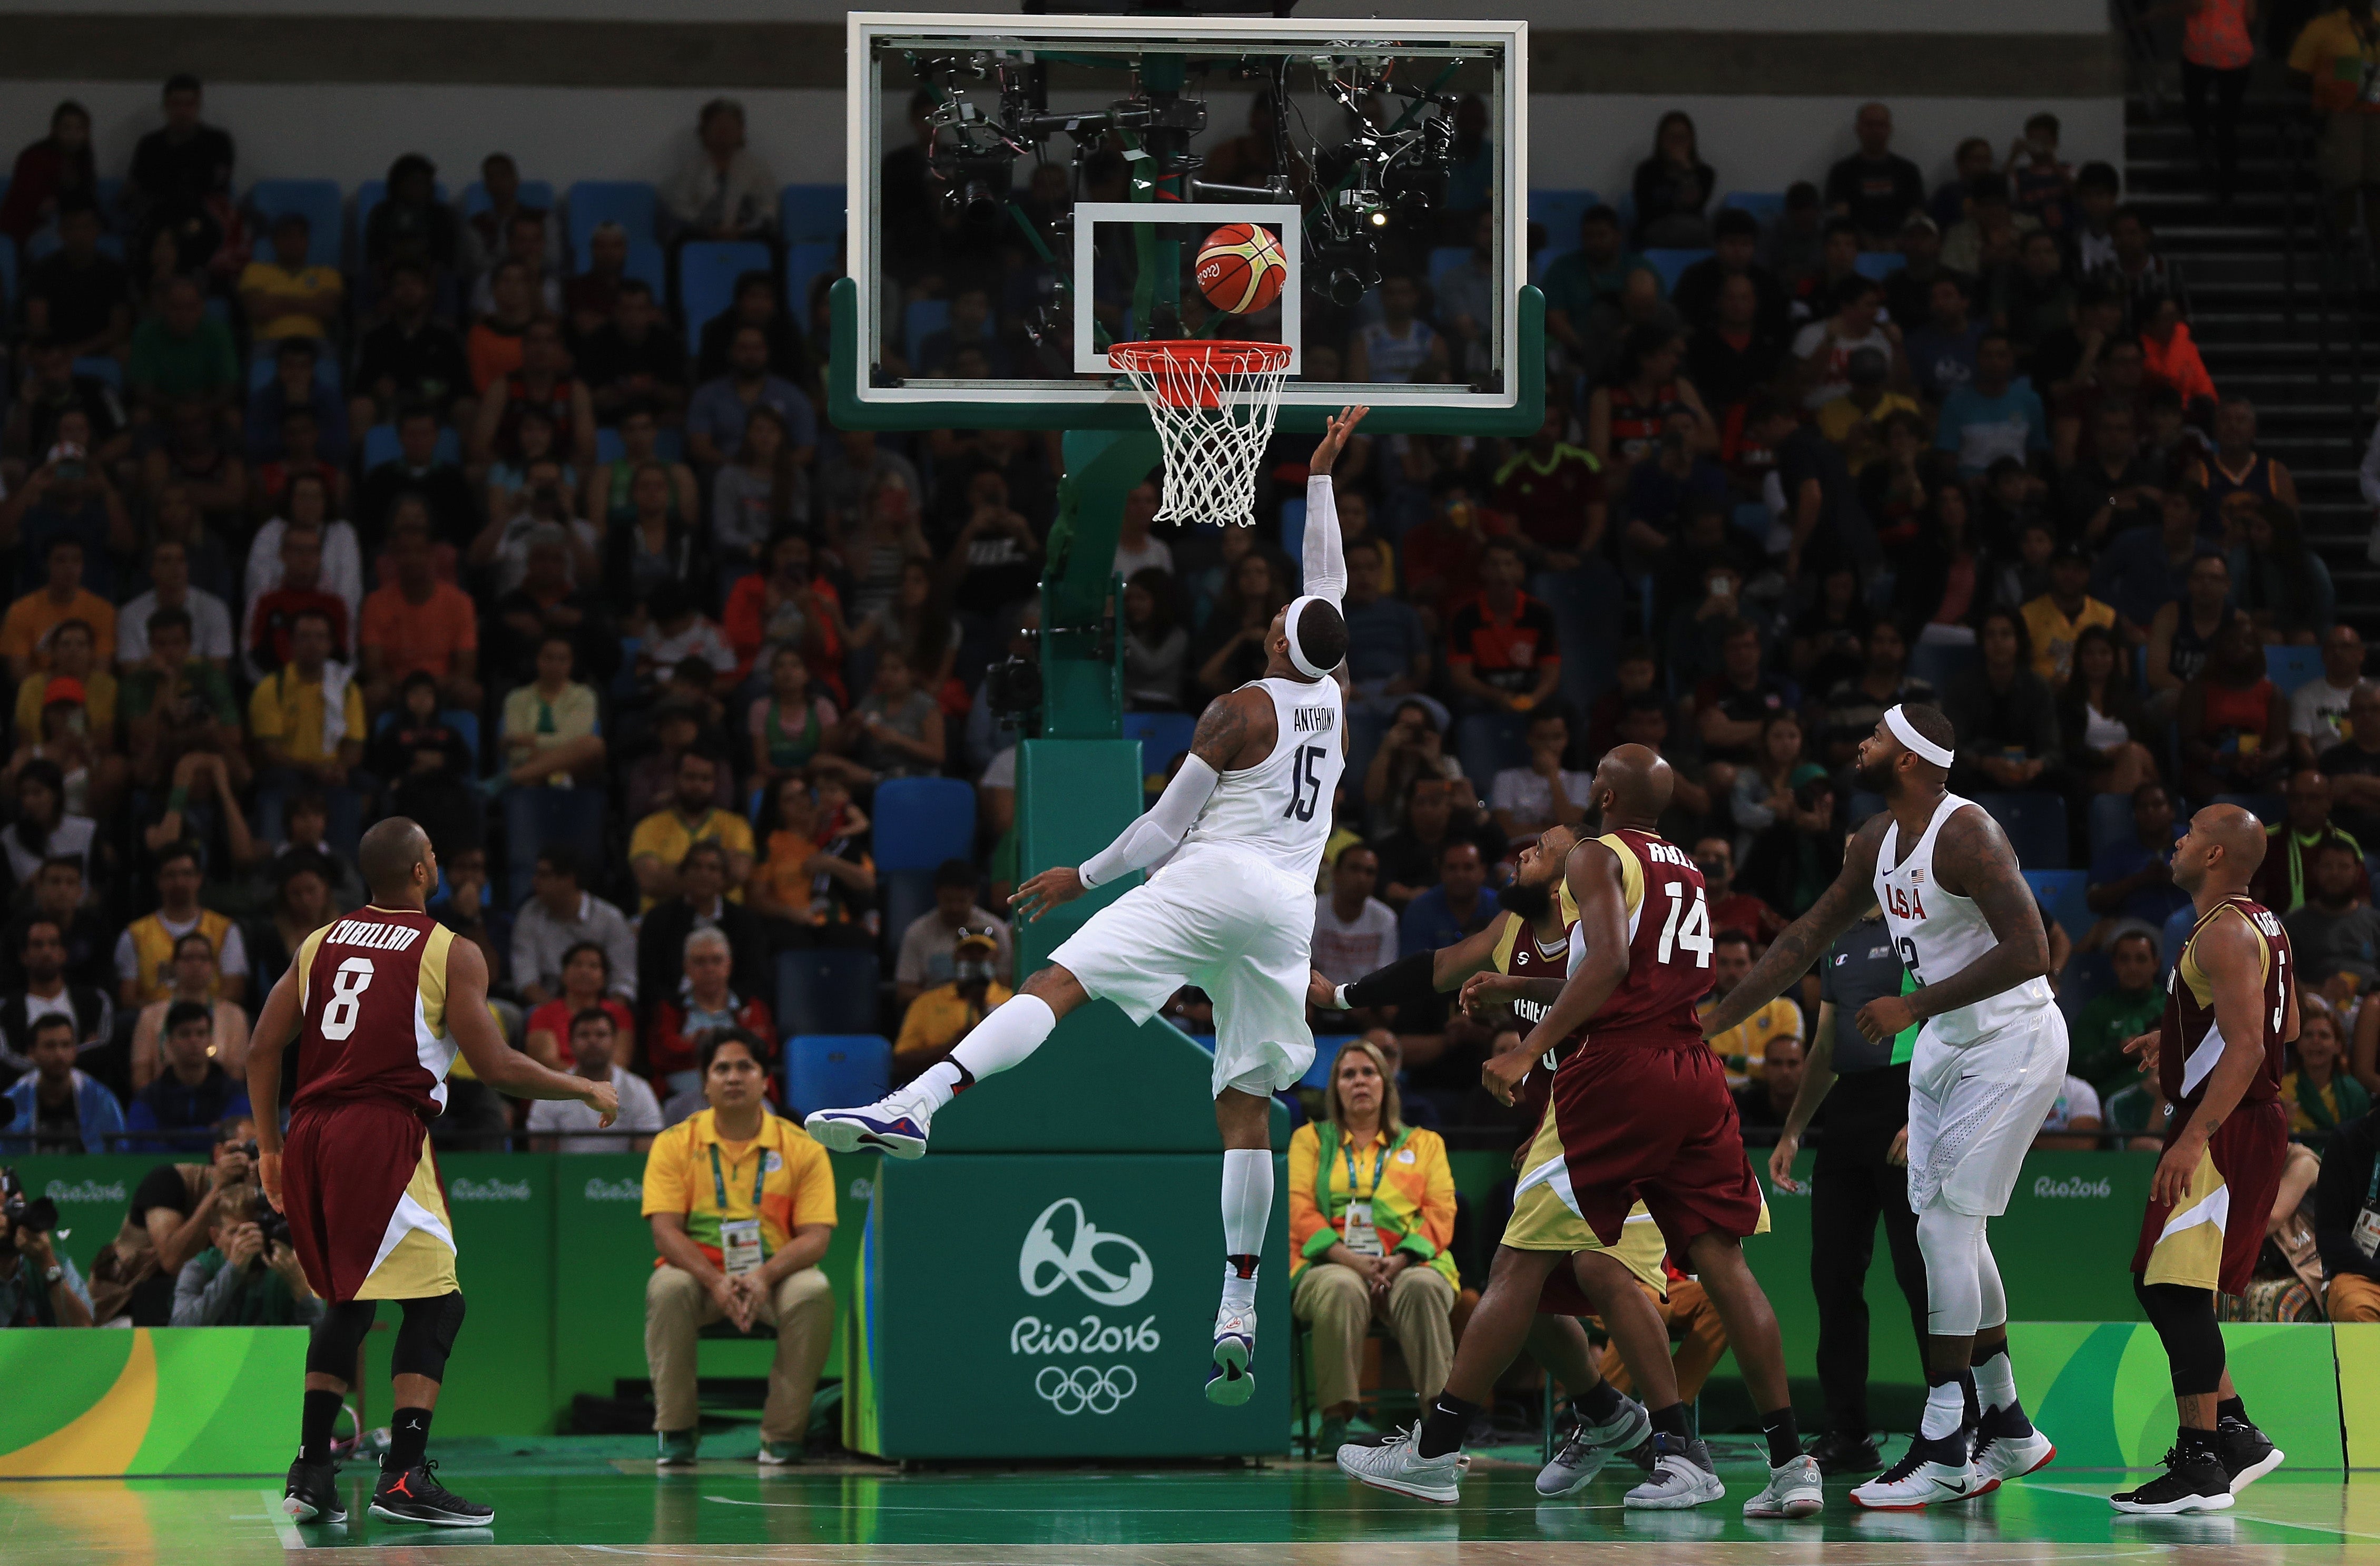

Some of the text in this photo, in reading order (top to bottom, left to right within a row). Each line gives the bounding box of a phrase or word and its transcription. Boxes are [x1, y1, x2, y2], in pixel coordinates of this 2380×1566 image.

[1294, 707, 1335, 732] ANTHONY
[1283, 744, 1327, 823] 15
[1885, 883, 1927, 920] USA
[326, 919, 421, 952] CUBILLAN
[1658, 881, 1714, 968] 14
[320, 956, 375, 1041] 8
[1513, 998, 1553, 1024] VENE
[2273, 950, 2286, 1034] 5
[2034, 1176, 2111, 1198] Rio2016
[1010, 1315, 1161, 1355] Rio2016
